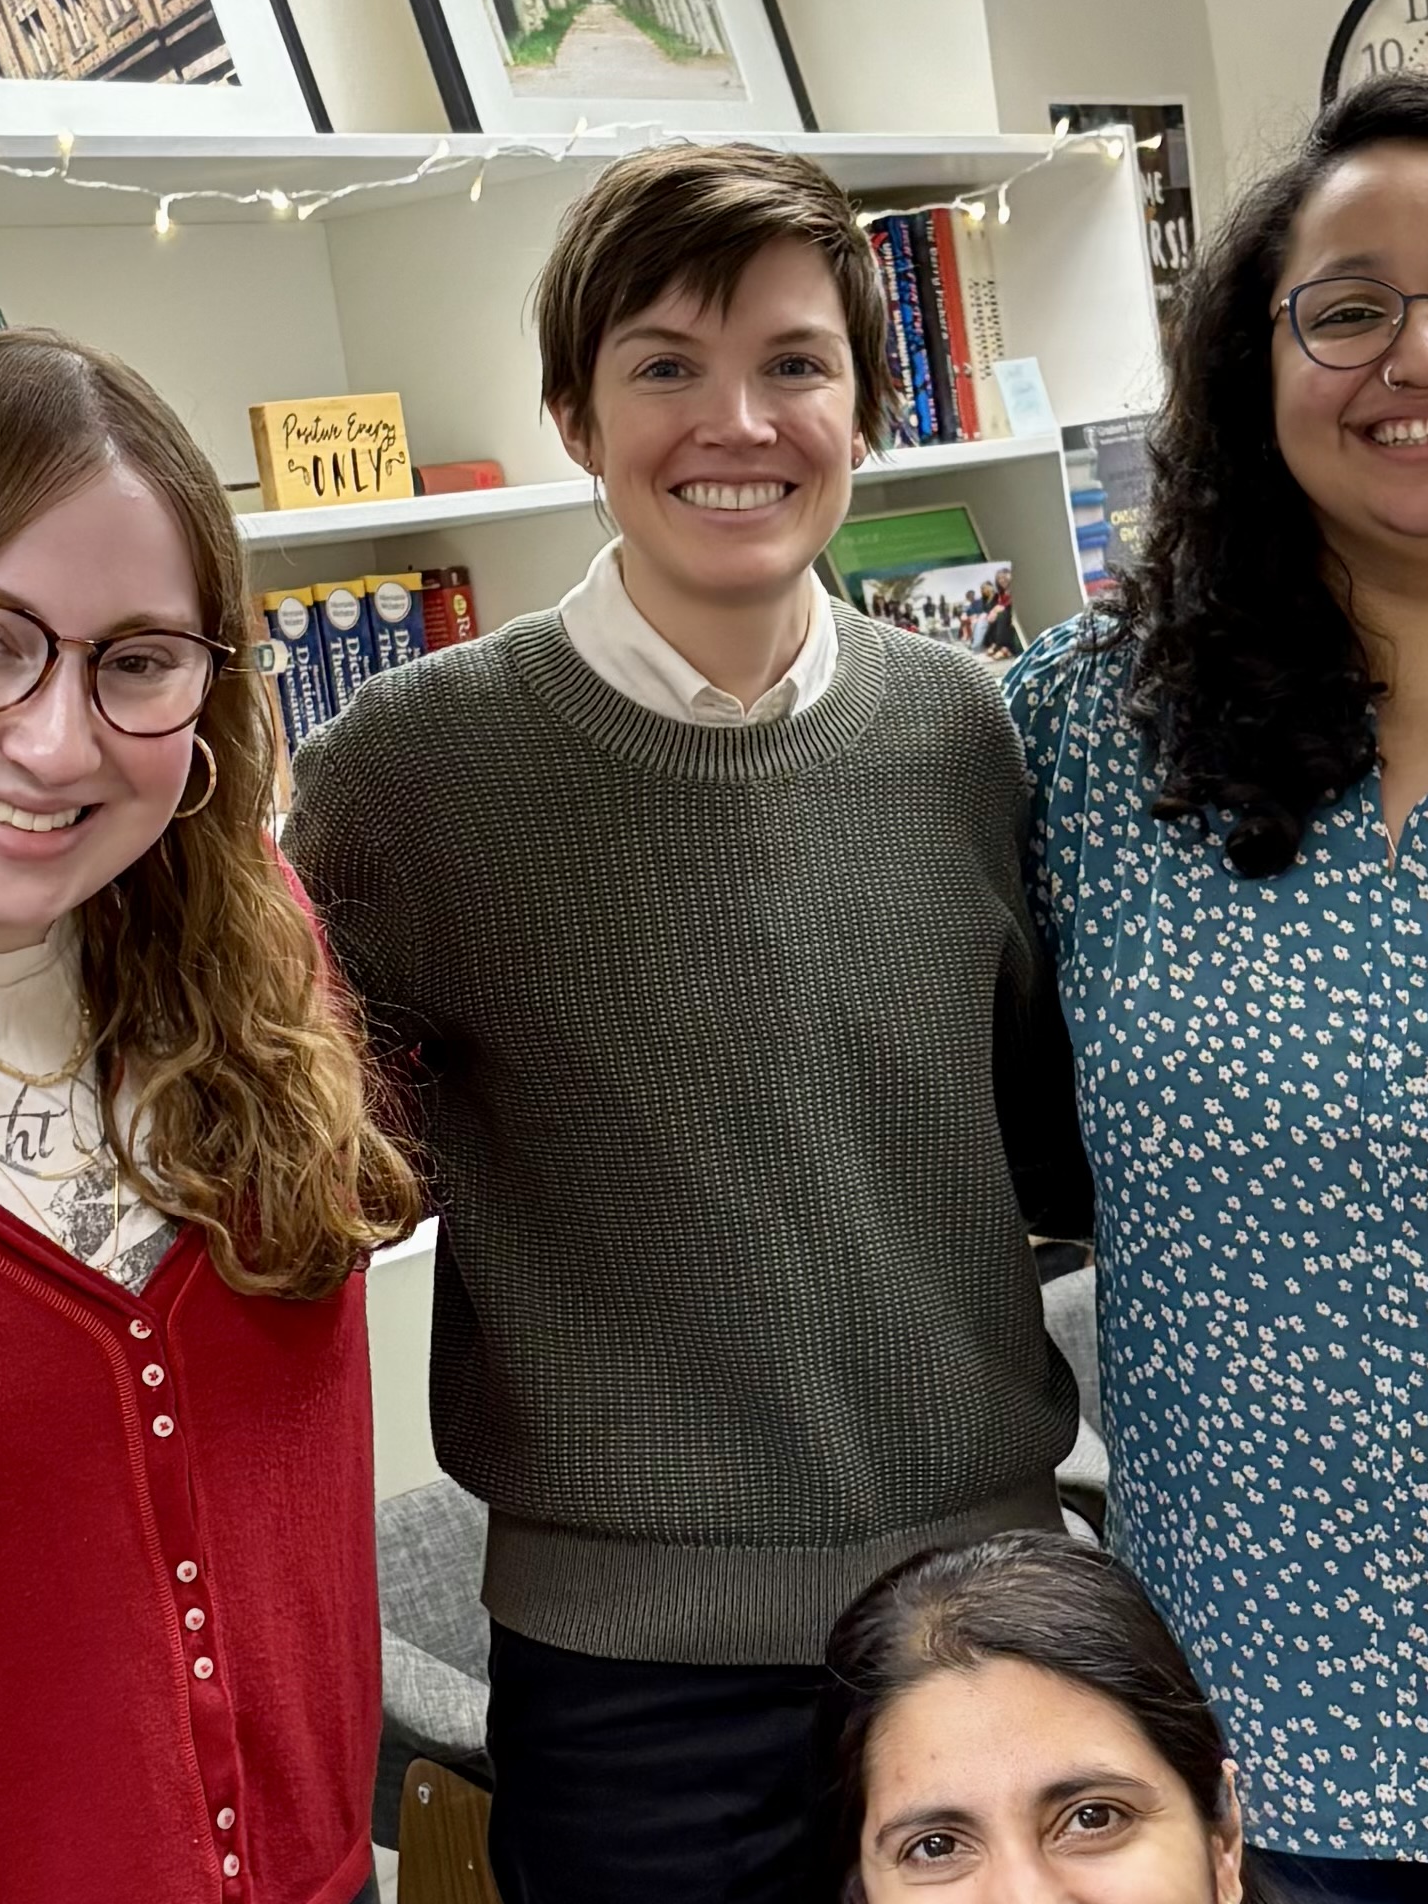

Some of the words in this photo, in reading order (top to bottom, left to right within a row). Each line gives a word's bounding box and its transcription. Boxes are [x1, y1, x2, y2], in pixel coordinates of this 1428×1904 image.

[1361, 38, 1404, 79] 10
[282, 412, 343, 449] Positive
[347, 412, 396, 452] Energy
[312, 446, 383, 497] ONLY
